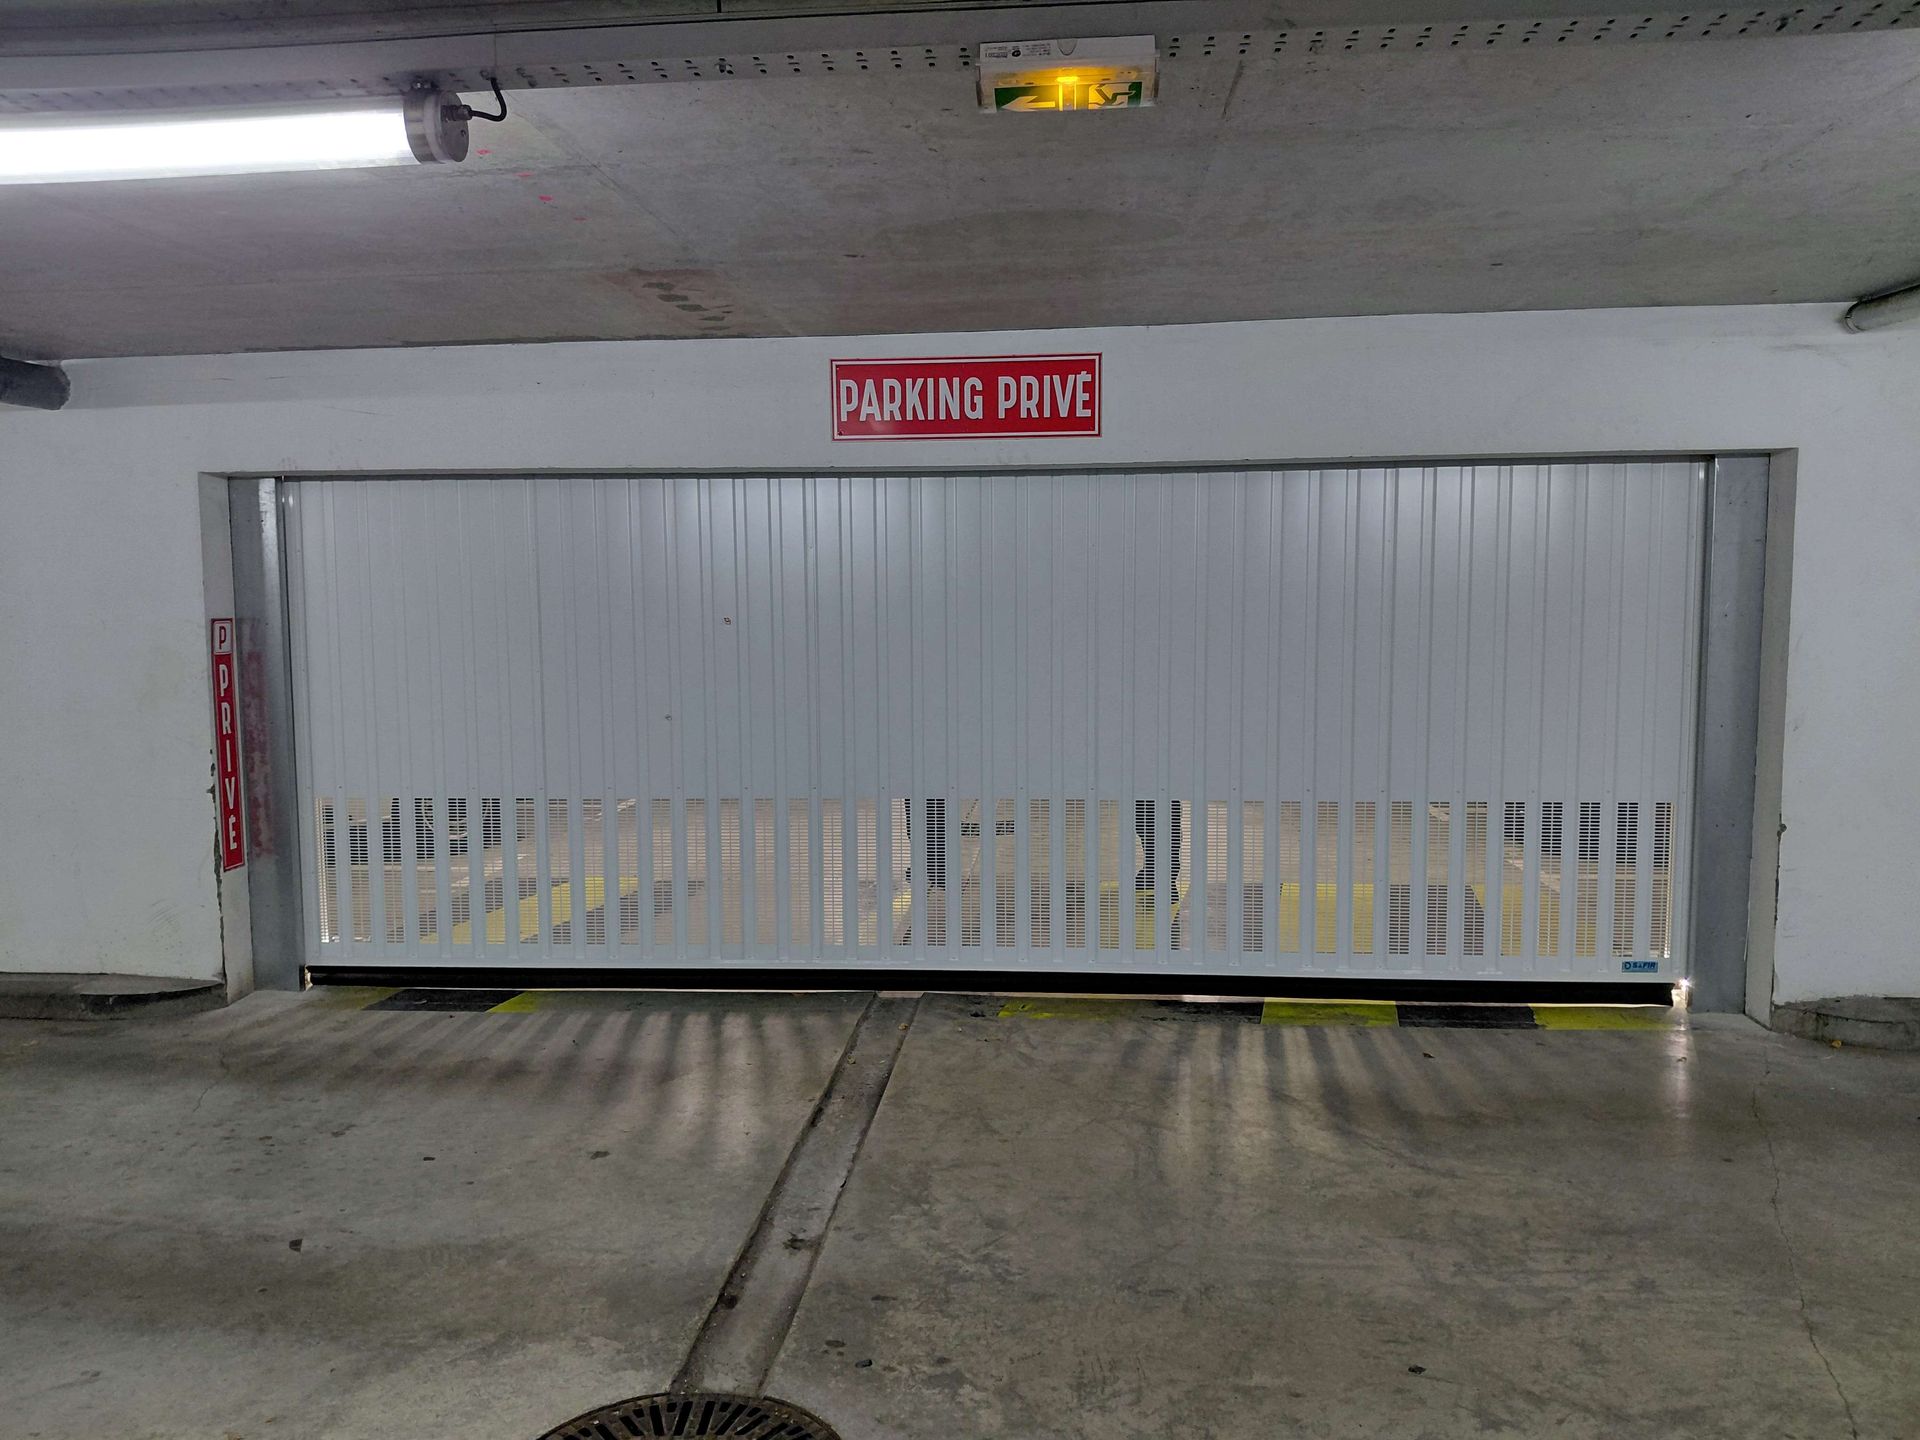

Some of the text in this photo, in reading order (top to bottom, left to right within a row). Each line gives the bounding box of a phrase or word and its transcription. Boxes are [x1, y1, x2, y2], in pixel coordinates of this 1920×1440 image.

[839, 370, 1092, 422] PARKING PRIVÉ
[218, 625, 227, 650] P
